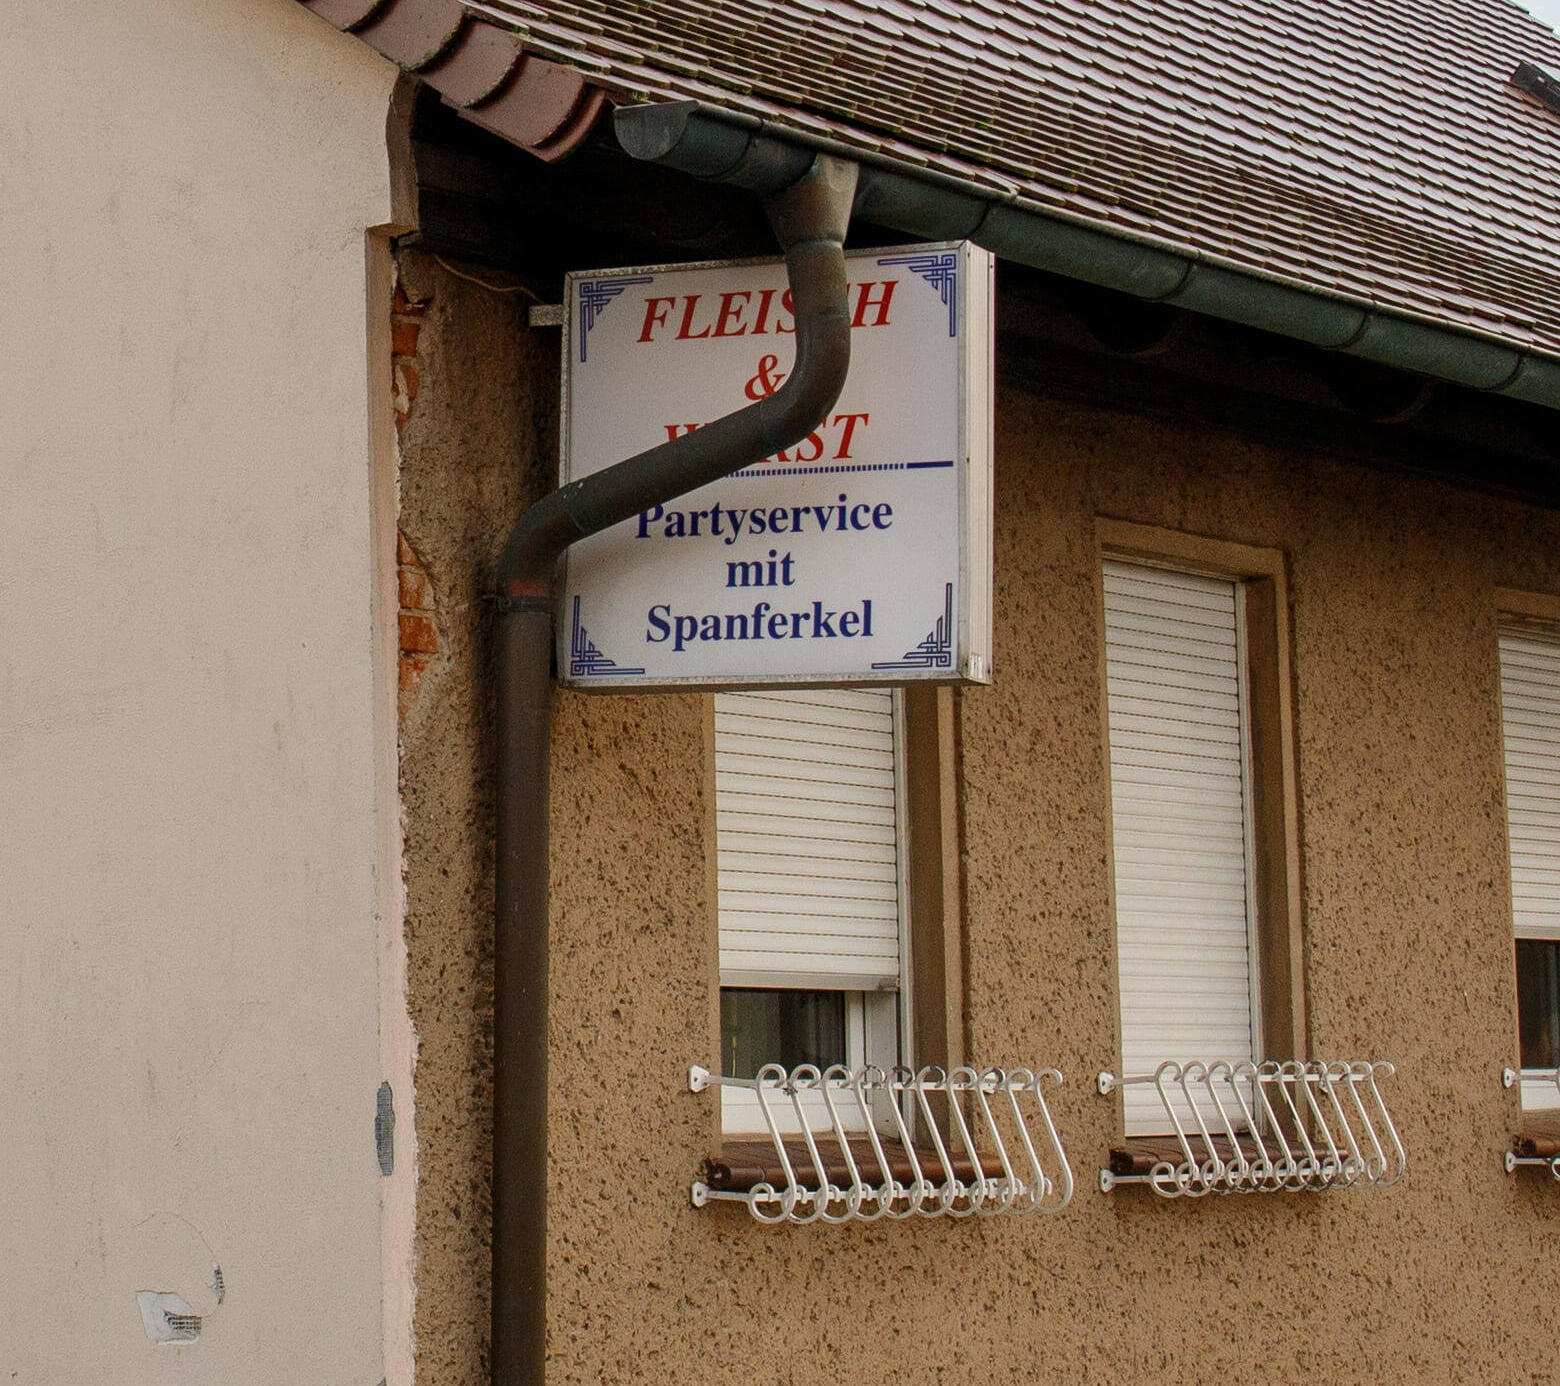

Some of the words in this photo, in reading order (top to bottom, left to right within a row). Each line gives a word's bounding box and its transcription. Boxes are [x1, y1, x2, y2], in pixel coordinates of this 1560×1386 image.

[636, 280, 900, 343] FLEISH
[744, 353, 792, 401] &
[634, 493, 894, 545] Partyservice
[725, 549, 796, 588] mit
[646, 599, 874, 652] Spanferkel
